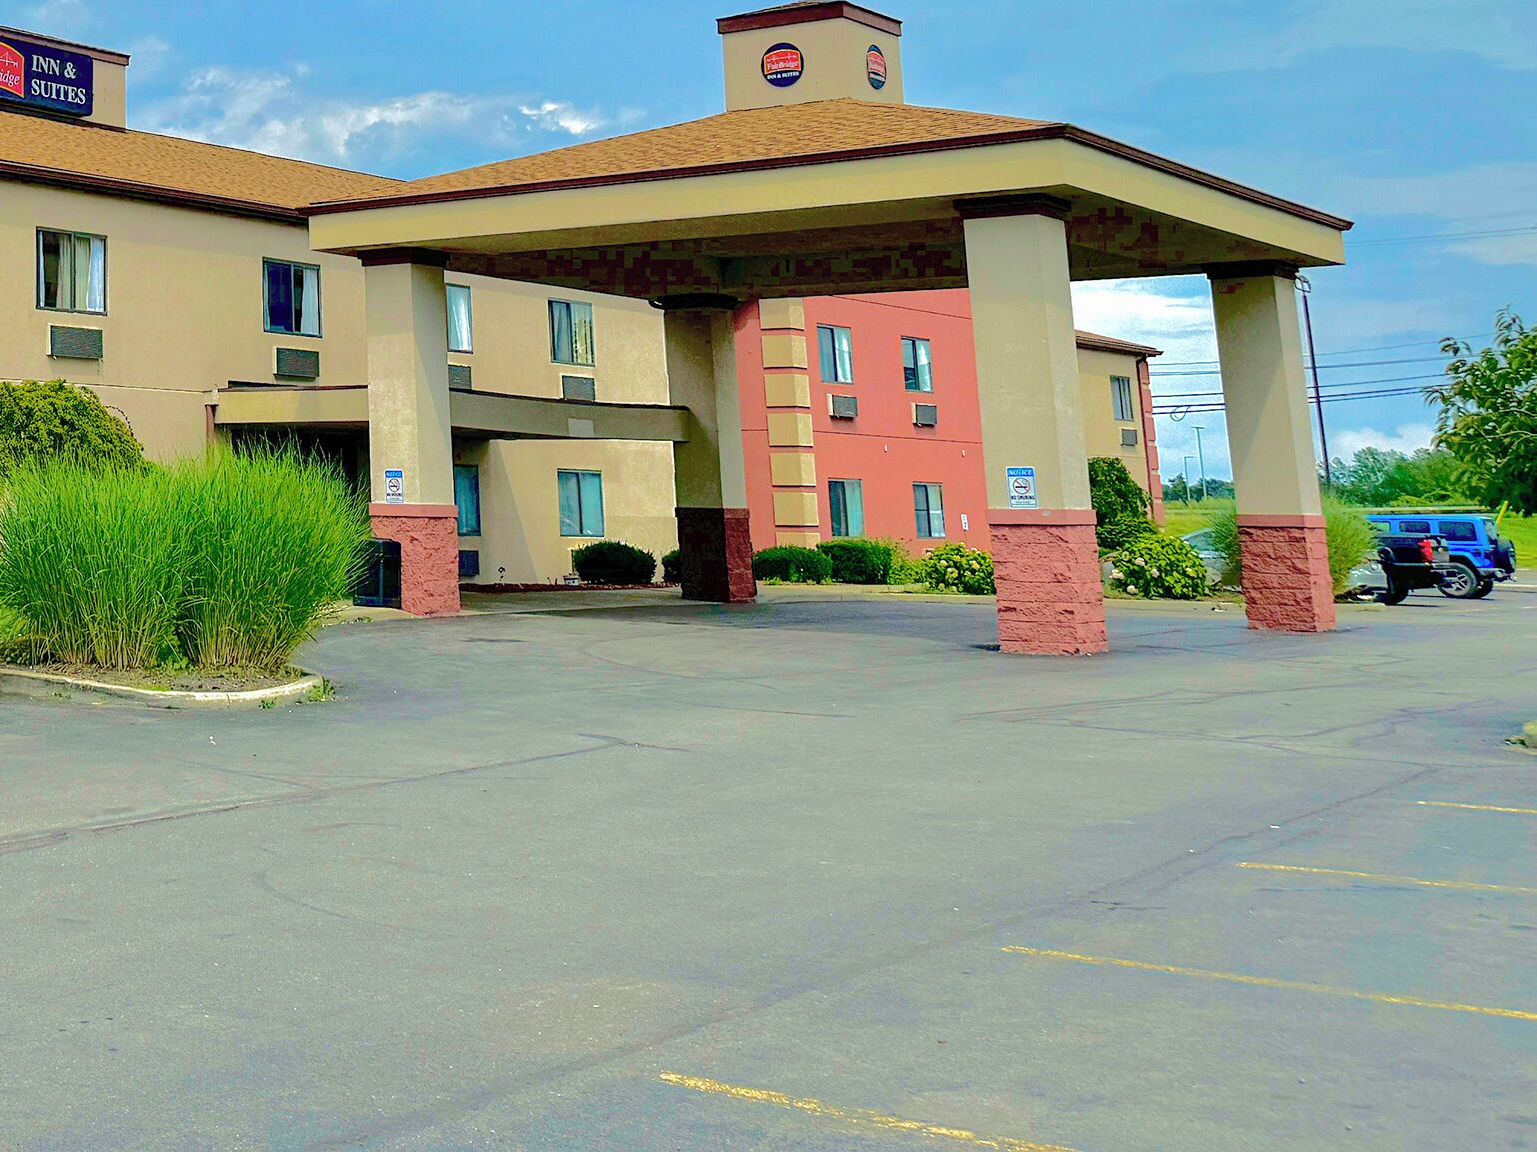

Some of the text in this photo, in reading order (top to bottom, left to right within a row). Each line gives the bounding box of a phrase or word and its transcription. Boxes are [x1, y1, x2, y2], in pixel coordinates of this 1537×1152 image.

[31, 54, 76, 79] INN &
[31, 79, 86, 105] SUITES
